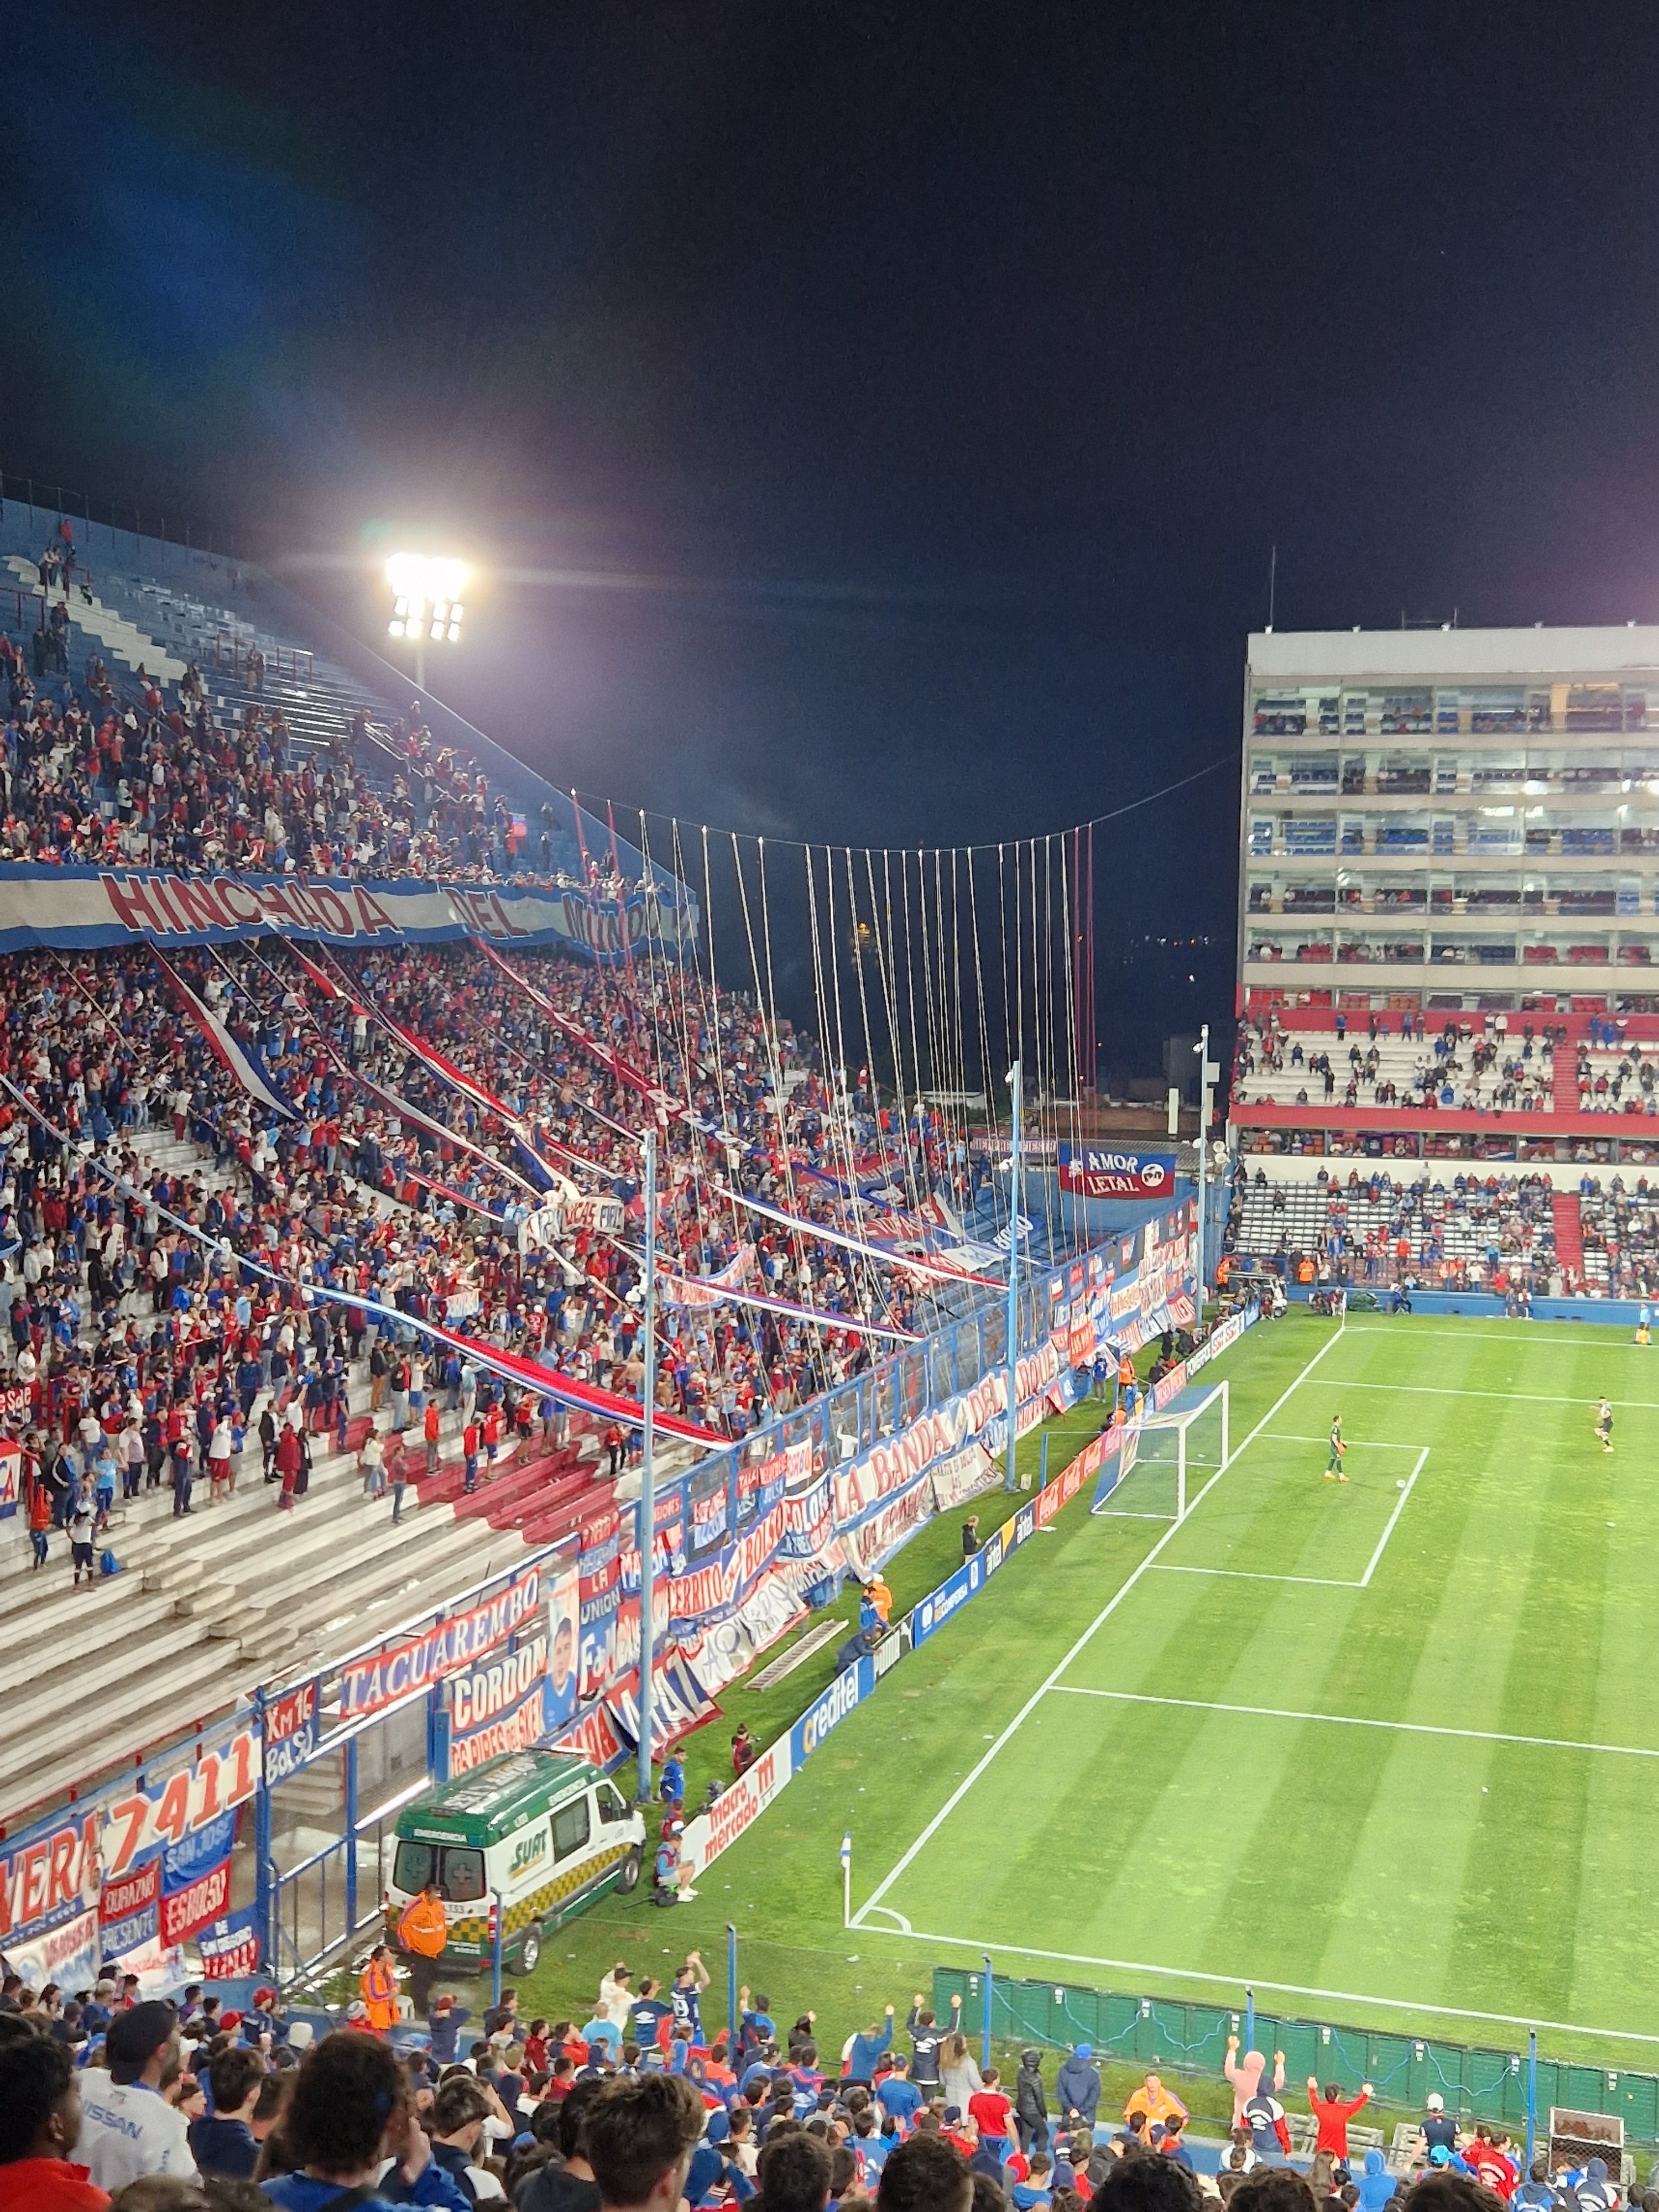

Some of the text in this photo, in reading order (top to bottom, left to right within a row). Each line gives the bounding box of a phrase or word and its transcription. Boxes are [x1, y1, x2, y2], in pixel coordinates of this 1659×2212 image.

[98, 872, 405, 938] HINCHADA
[443, 886, 533, 939] DEL
[1087, 1176, 1140, 1194] LETAL
[1088, 1152, 1139, 1175] AMOR
[832, 1464, 866, 1522] LA
[870, 1410, 952, 1498] BANDA
[968, 1373, 1004, 1434] DEL
[1017, 1510, 1033, 1544] antel
[592, 1569, 608, 1593] LA
[986, 1539, 1002, 1575] antel
[581, 1586, 621, 1625] UNION
[342, 1569, 540, 1714] TACUAREMBO
[454, 1635, 547, 1729] CORDON
[802, 1662, 859, 1754] creditel
[111, 1732, 255, 1877] 7411
[705, 1792, 758, 1865] mercado
[710, 1780, 747, 1833] macro
[510, 1828, 548, 1872] SUAT
[105, 1870, 155, 1915] DURAZNO
